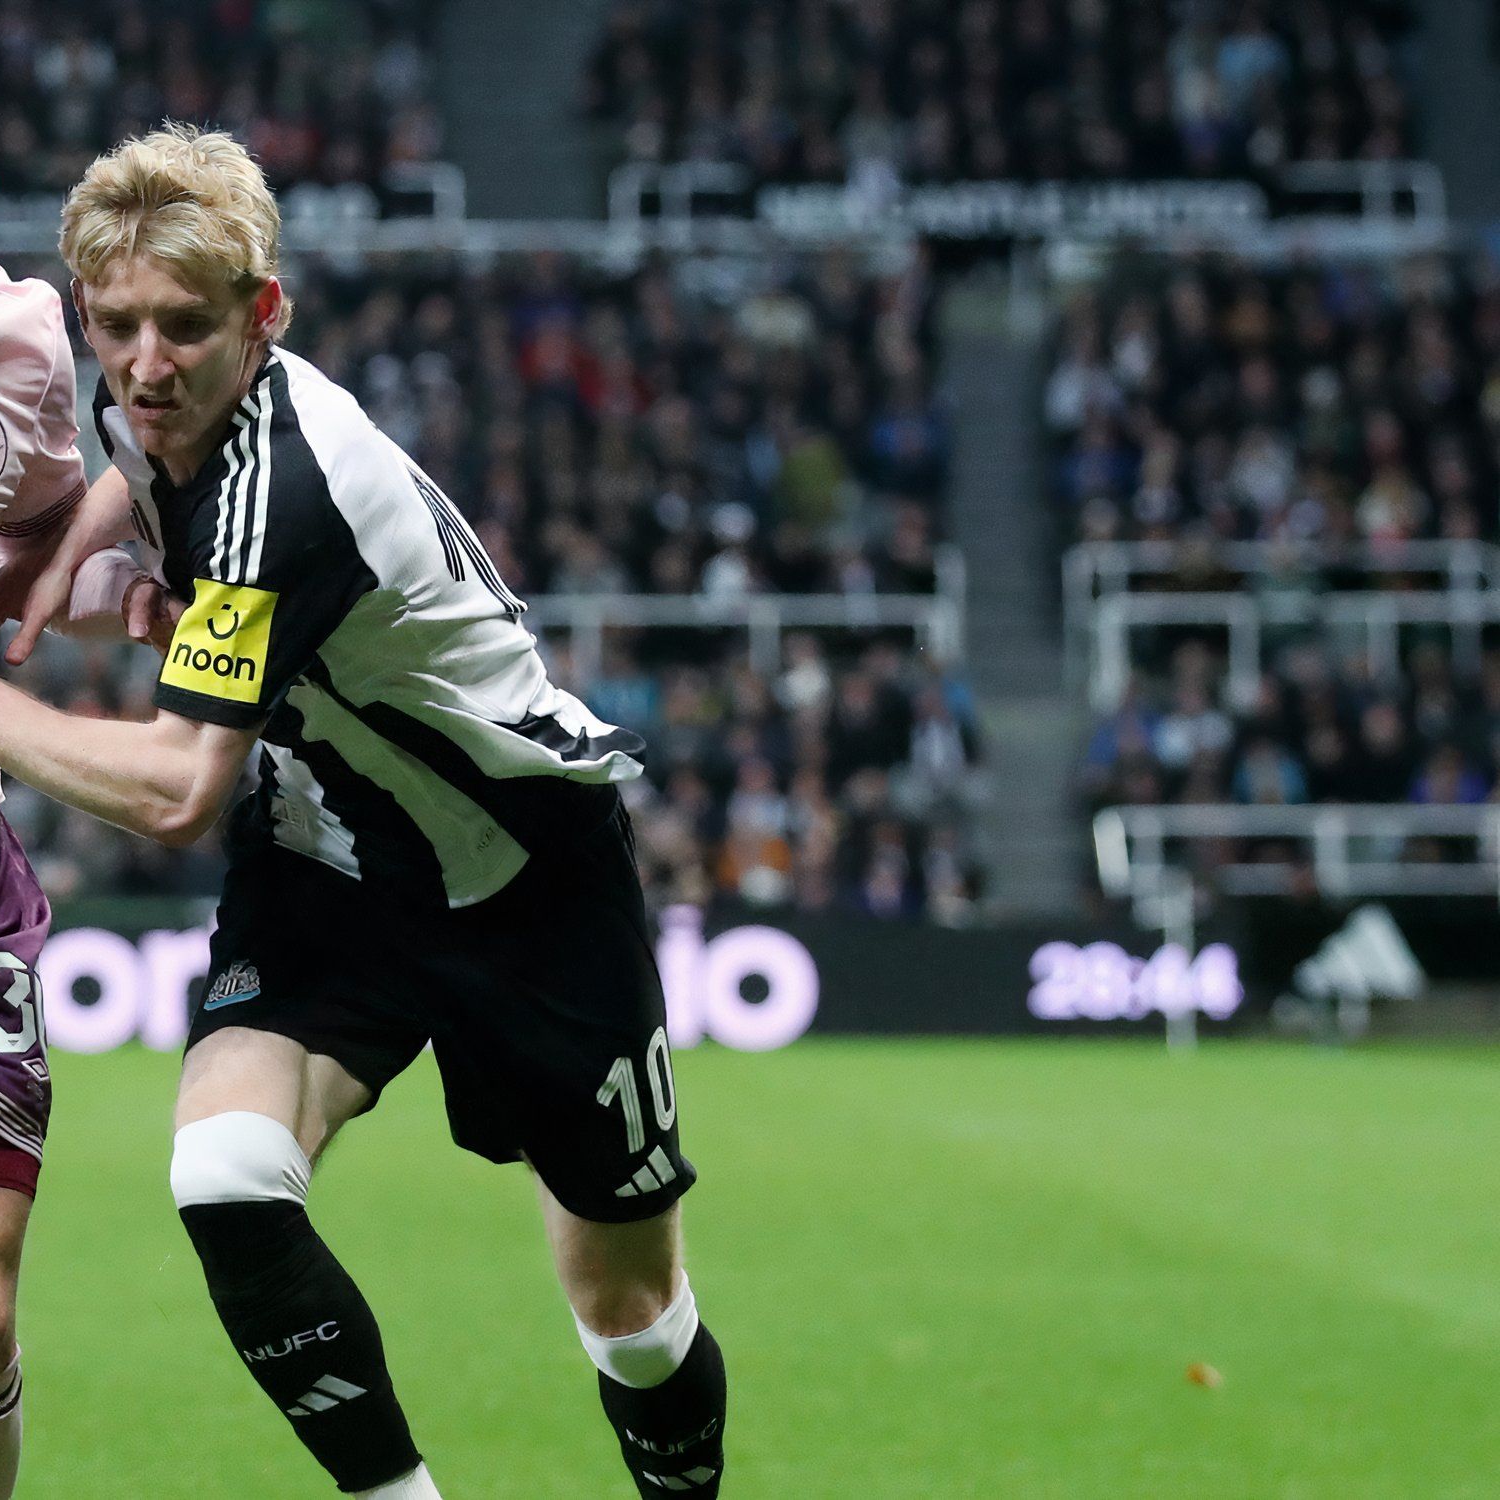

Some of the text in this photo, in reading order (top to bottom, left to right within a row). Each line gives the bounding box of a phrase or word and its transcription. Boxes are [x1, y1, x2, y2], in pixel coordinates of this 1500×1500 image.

[172, 642, 256, 681] noon
[596, 1025, 676, 1154] 10
[243, 1320, 340, 1363] NUFC
[625, 1417, 718, 1456] NUFC
